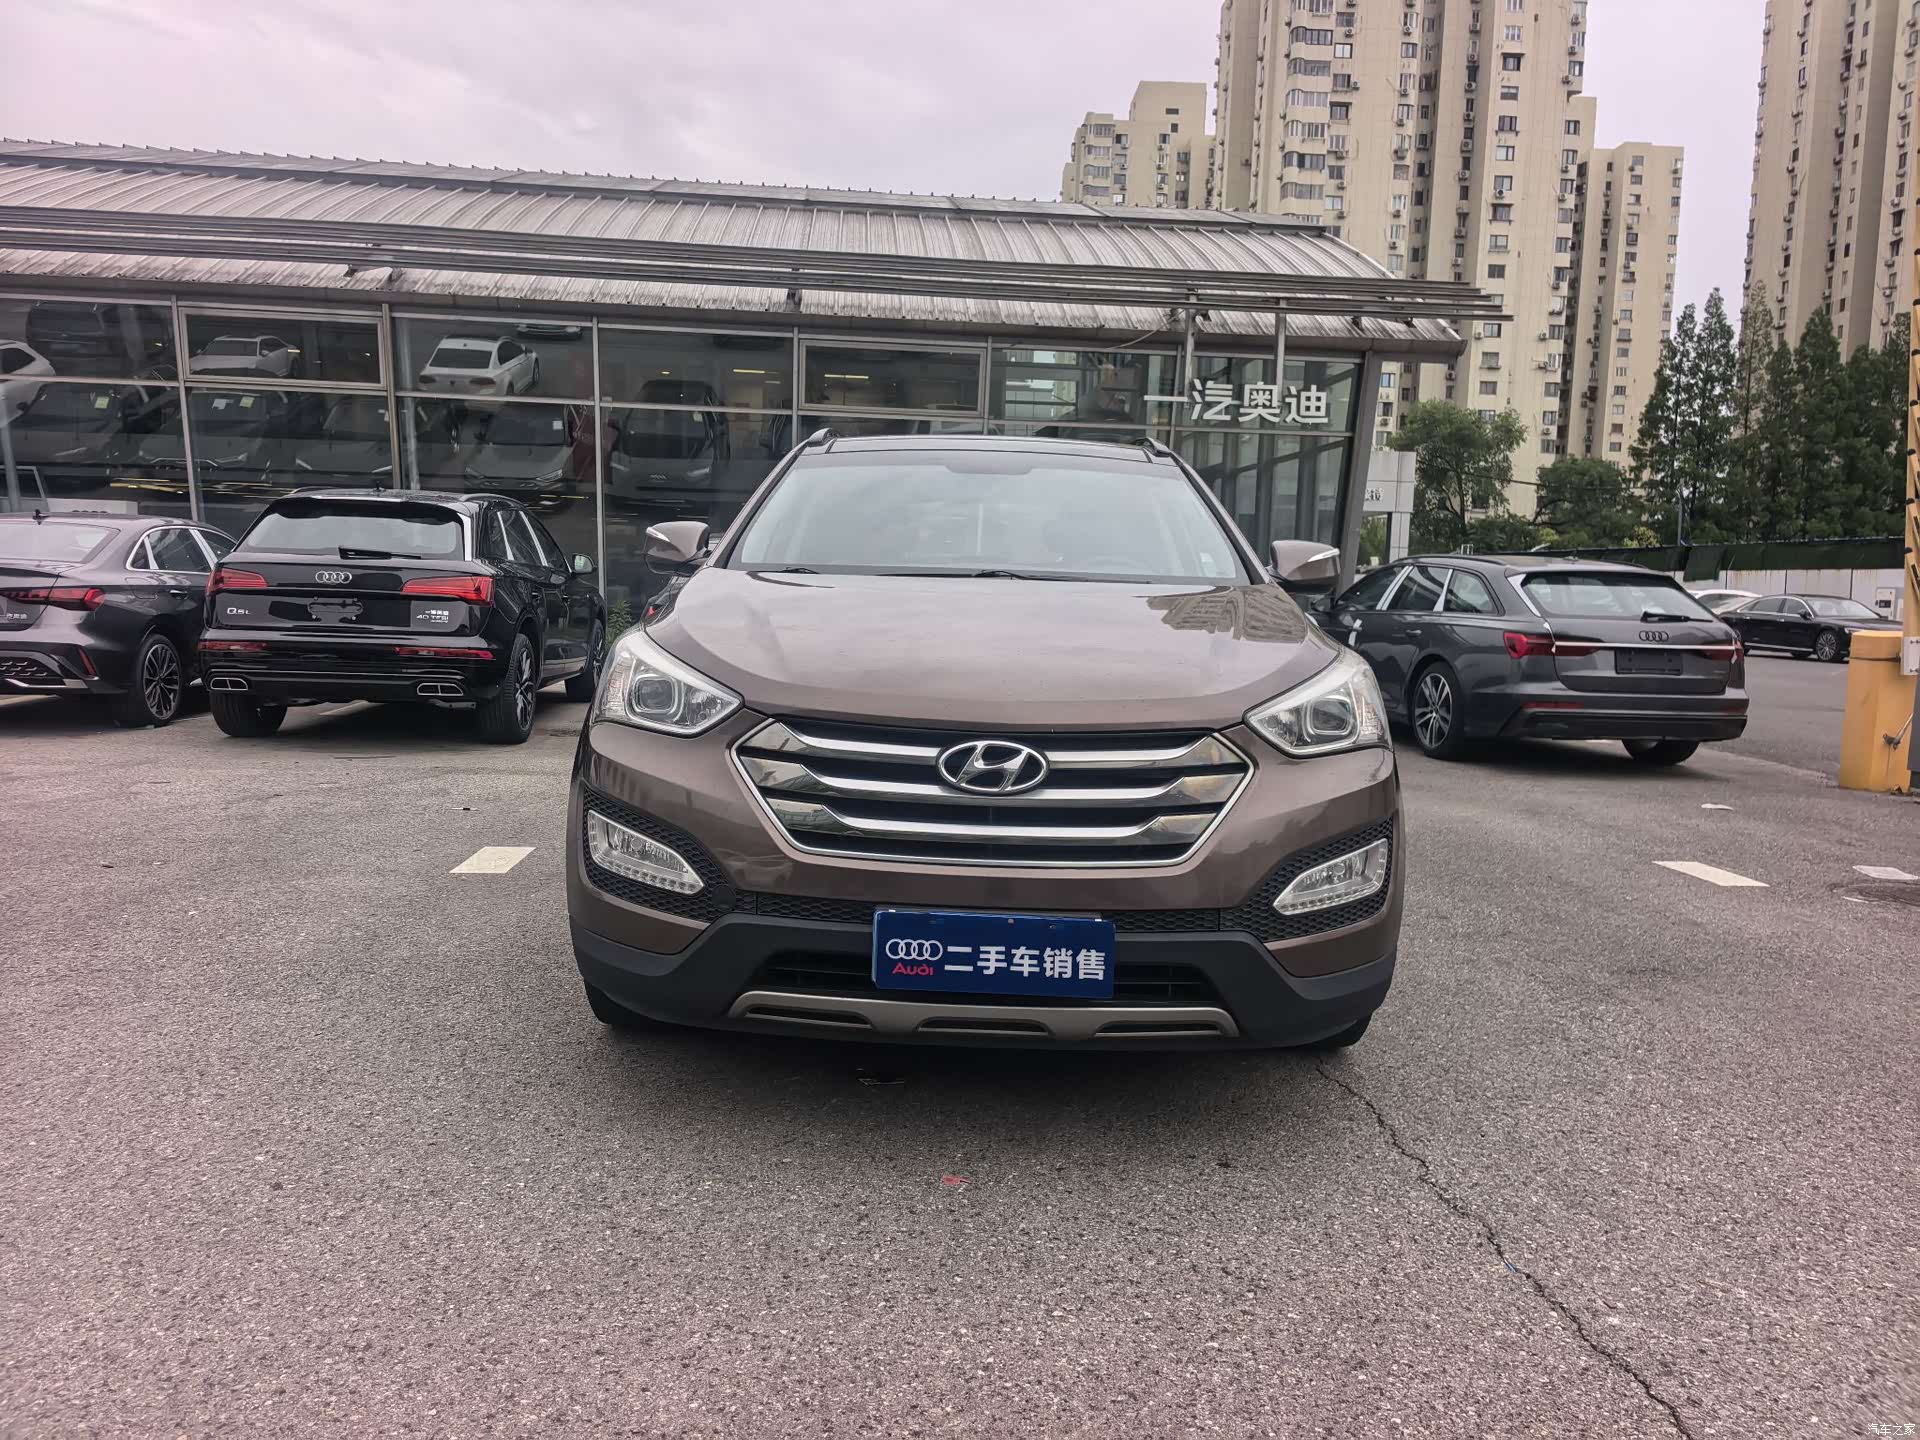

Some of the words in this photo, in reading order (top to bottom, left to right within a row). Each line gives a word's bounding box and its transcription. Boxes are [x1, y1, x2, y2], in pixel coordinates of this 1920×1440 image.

[1144, 378, 1329, 424] 一汽奥迪
[892, 962, 934, 976] Audi
[944, 945, 1106, 981] 二手车销售
